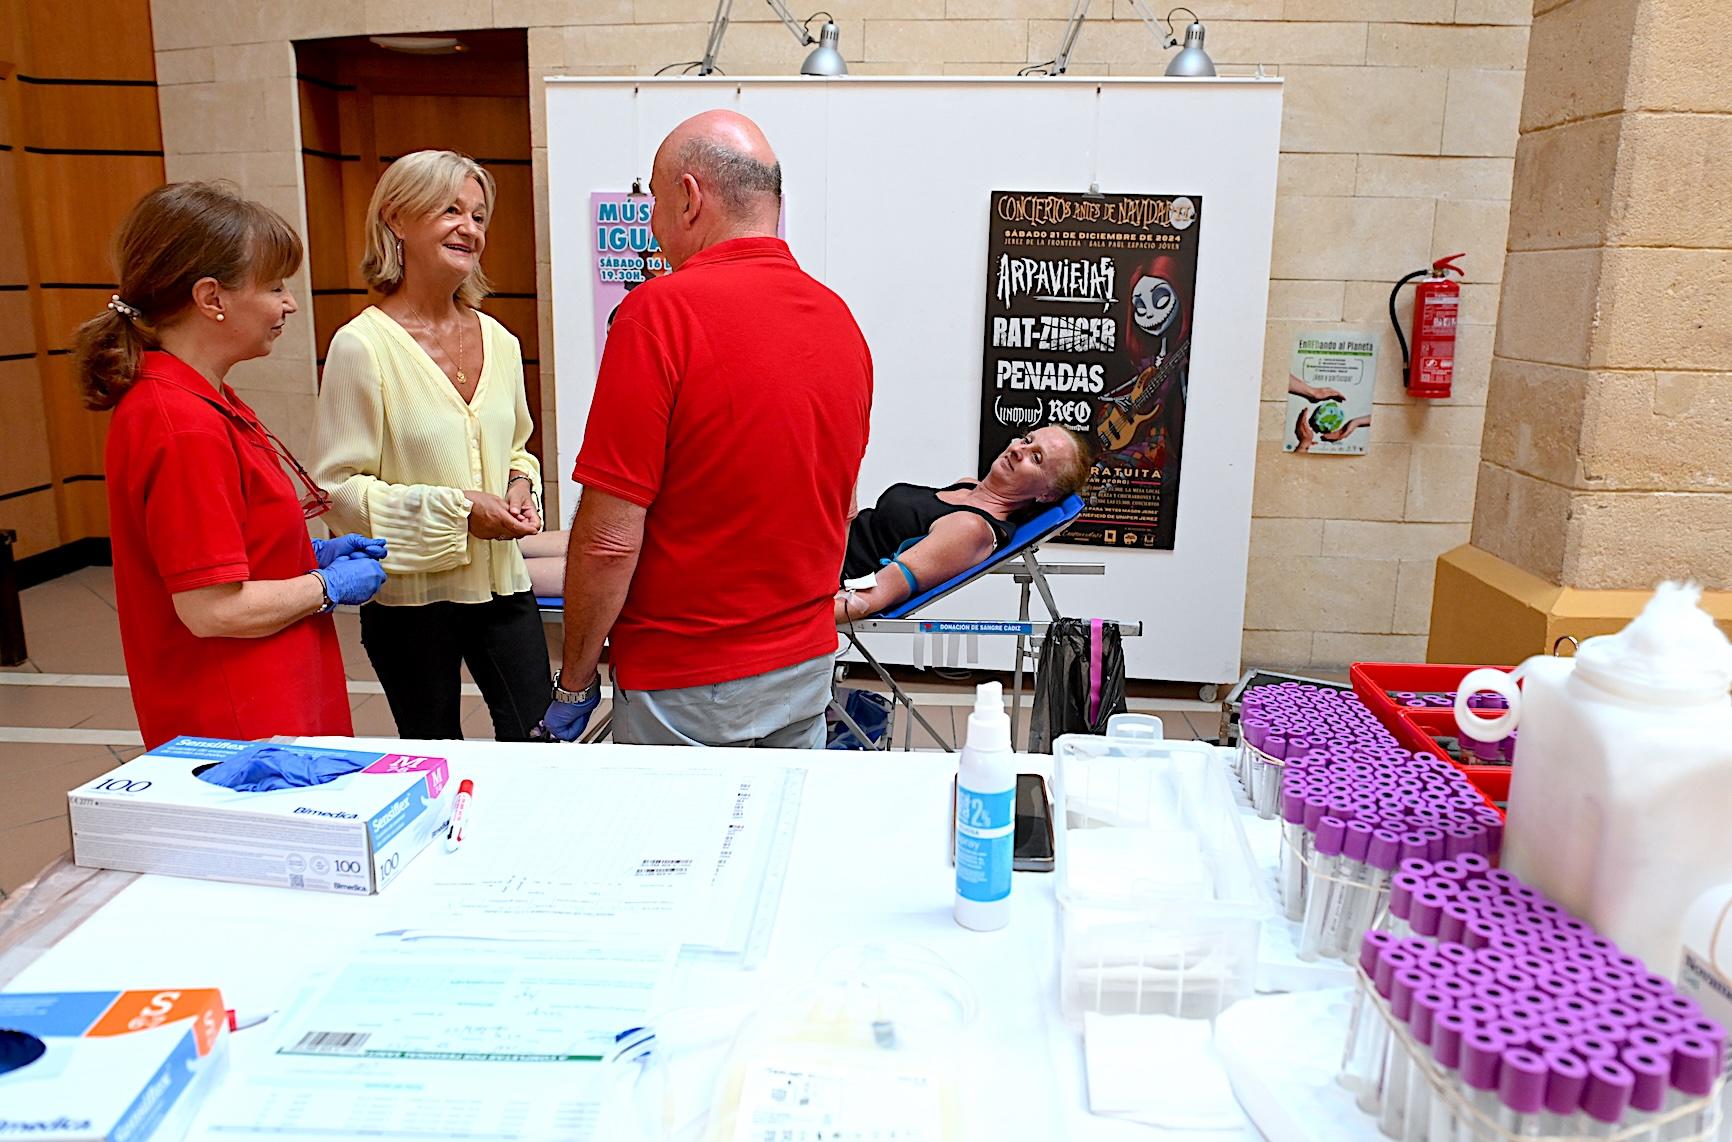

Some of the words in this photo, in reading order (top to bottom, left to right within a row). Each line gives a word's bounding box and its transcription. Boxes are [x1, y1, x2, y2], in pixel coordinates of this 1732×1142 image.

[599, 199, 652, 221] MÚS
[997, 196, 1071, 226] CONCIERTOS
[1073, 203, 1100, 222] ANTES
[1103, 203, 1117, 223] DE
[1004, 229, 1047, 238] SÁBADO
[1050, 231, 1059, 239] 21
[1063, 231, 1076, 239] DE
[1079, 232, 1136, 241] DICIEMBRE
[1155, 234, 1181, 242] 2024
[1004, 238, 1024, 246] JEREZ
[1047, 239, 1081, 247] FRONTERA
[1089, 240, 1105, 248] SALA
[600, 257, 643, 268] SÁBADO
[649, 259, 661, 268] 16
[997, 253, 1116, 308] ARPAVIEJAS
[993, 316, 1116, 352] RAT-ZINGER
[1347, 342, 1373, 351] Planeta
[996, 360, 1105, 393] PENADAS
[1048, 400, 1091, 423] REO
[1090, 466, 1162, 479] RATUITA
[176, 739, 249, 750] Sensiflex
[389, 756, 428, 769] M
[432, 767, 443, 786] M
[92, 778, 152, 793] 100
[335, 860, 361, 874] 100
[380, 852, 399, 880] 100
[140, 991, 181, 1018] S
